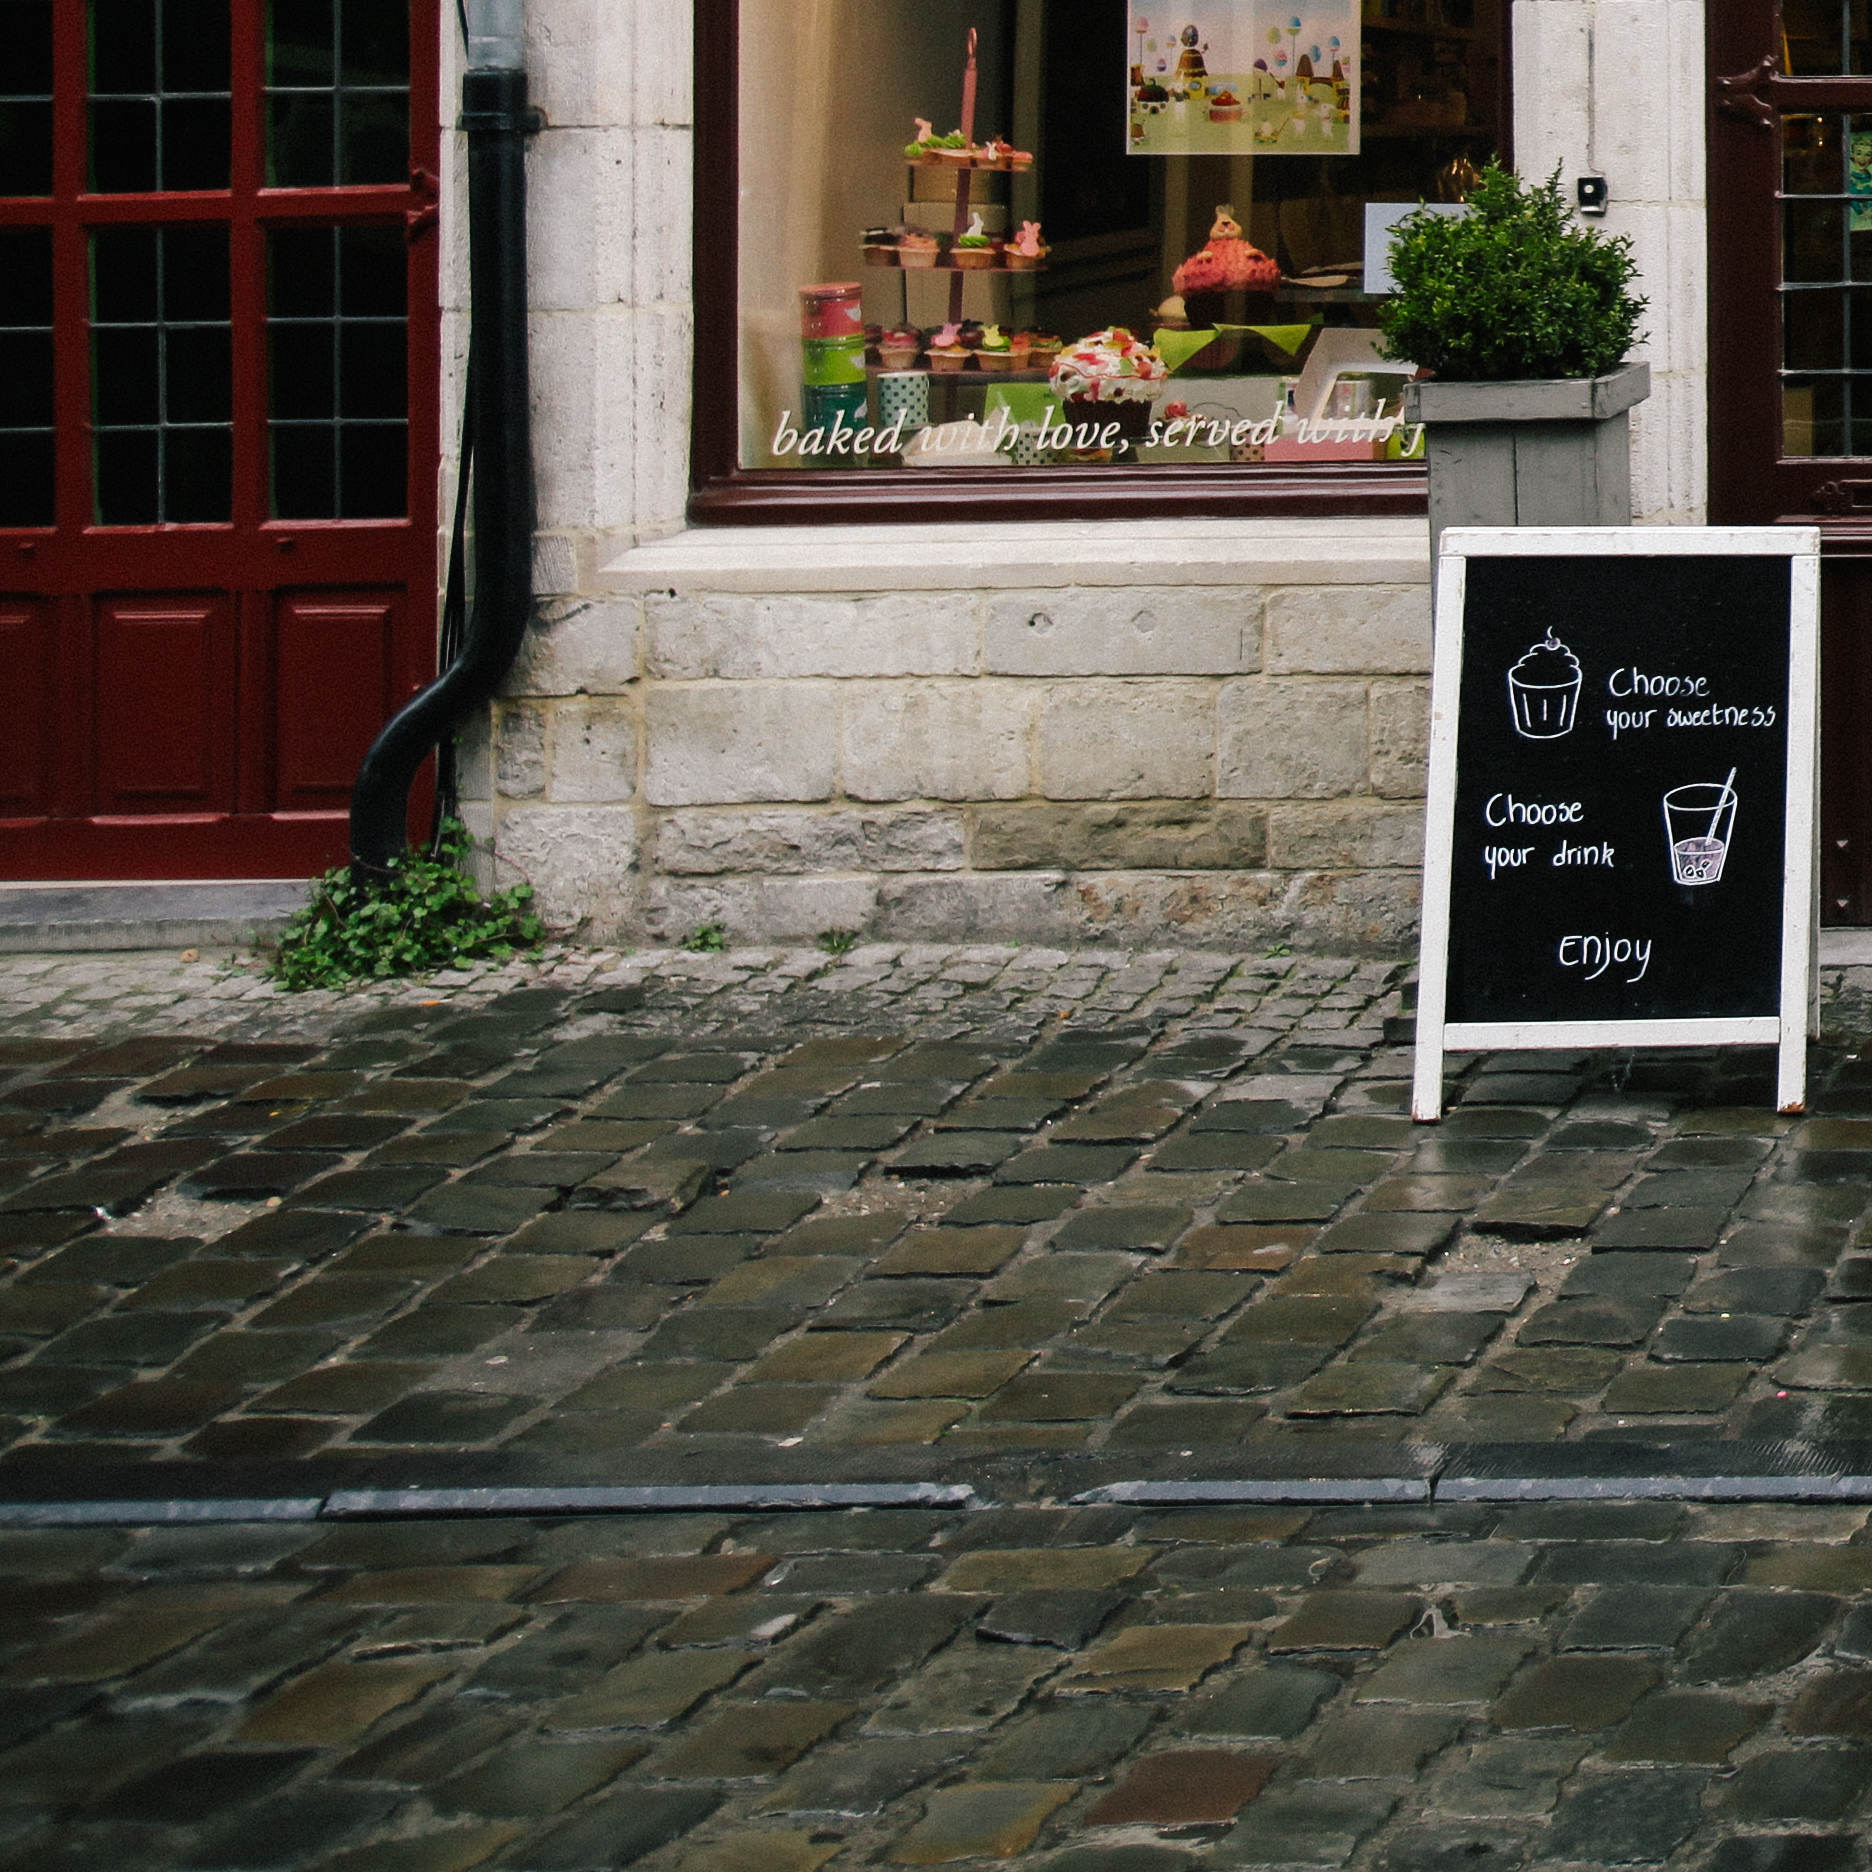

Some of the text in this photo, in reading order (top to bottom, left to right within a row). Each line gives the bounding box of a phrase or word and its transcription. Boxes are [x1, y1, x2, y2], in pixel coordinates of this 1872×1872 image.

[772, 409, 903, 456] baked
[918, 406, 1019, 454] with
[1035, 406, 1130, 455] love,
[1145, 400, 1284, 448] served
[1297, 397, 1404, 445] with
[1608, 666, 1710, 699] Choose
[1605, 705, 1777, 741] your sweetness
[1485, 792, 1584, 827] Choose
[1484, 838, 1615, 881] your drink
[1559, 933, 1652, 983] Enjoy
